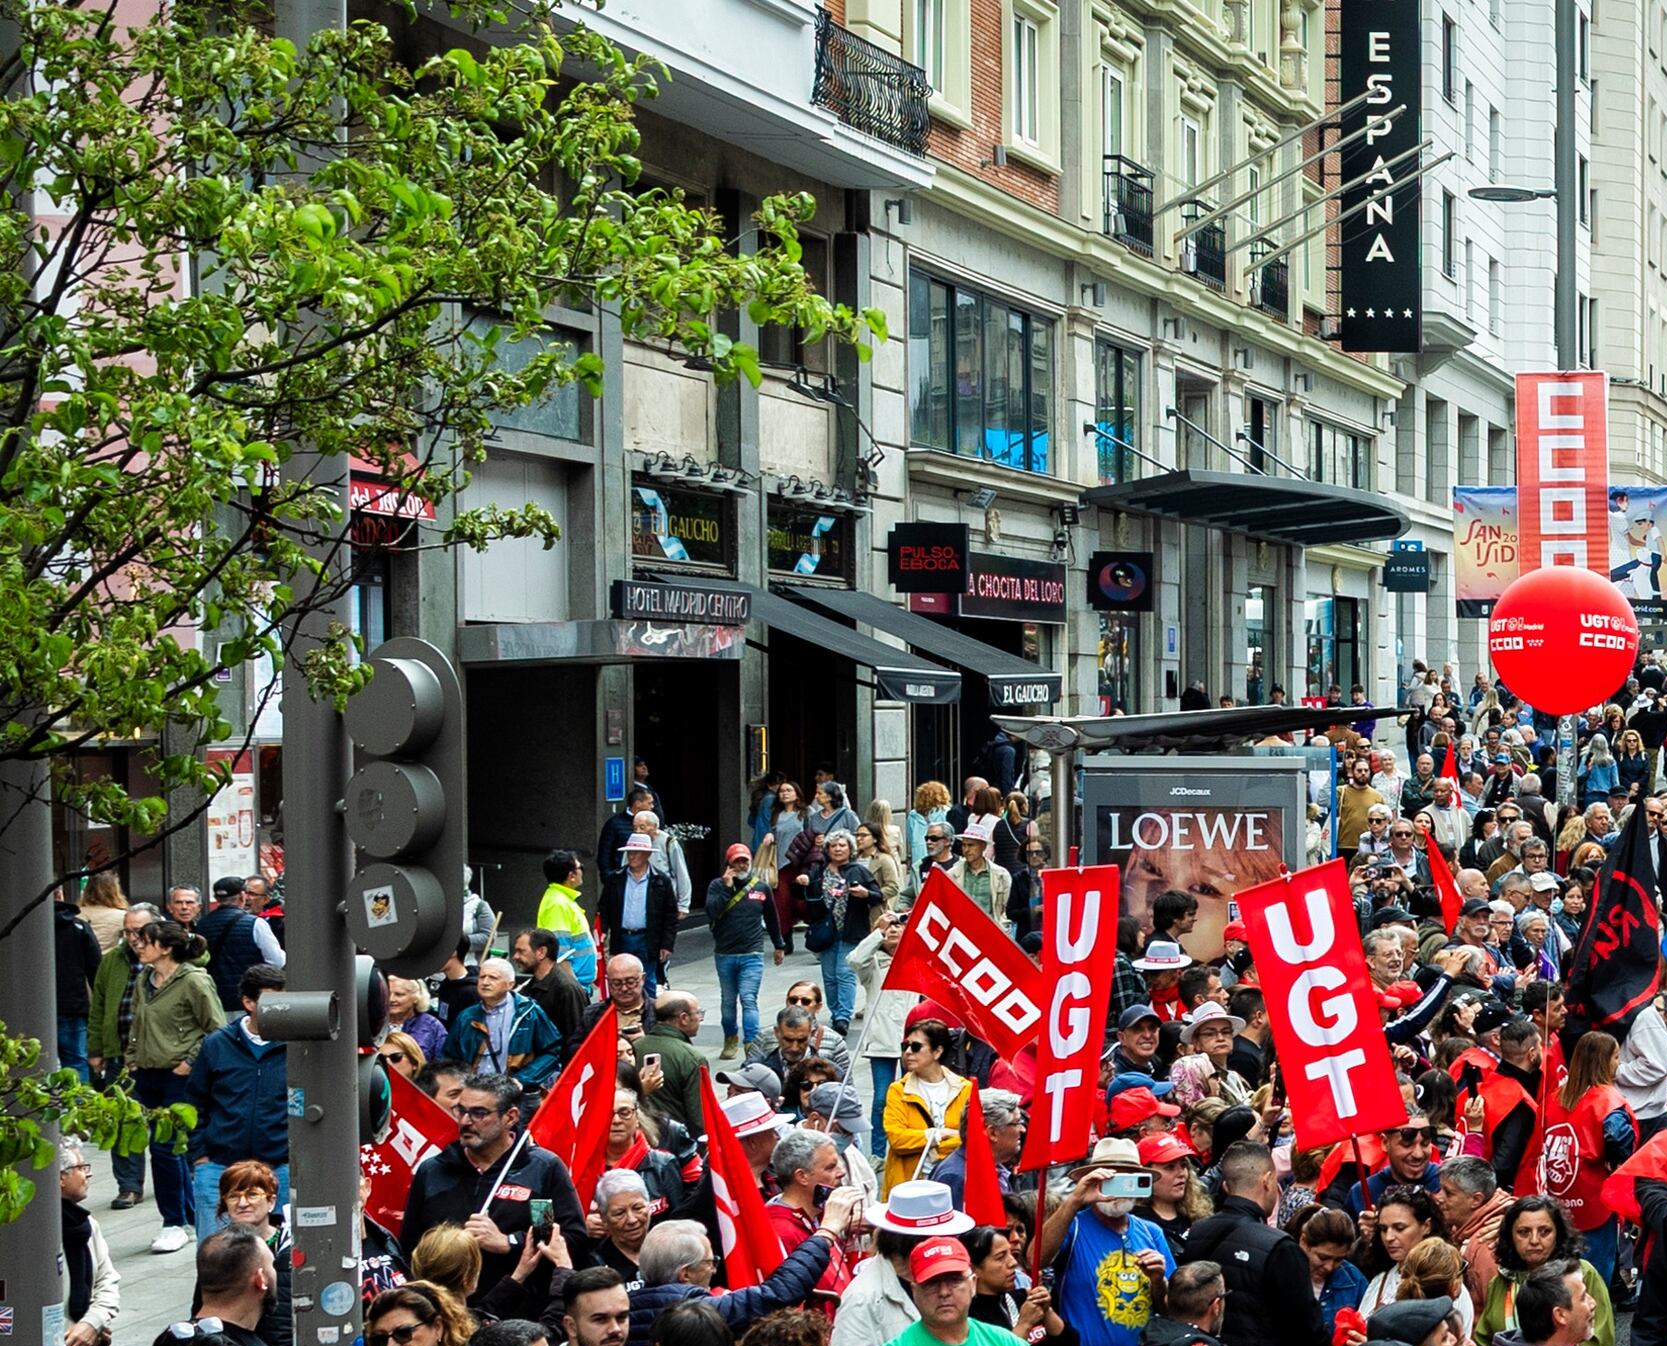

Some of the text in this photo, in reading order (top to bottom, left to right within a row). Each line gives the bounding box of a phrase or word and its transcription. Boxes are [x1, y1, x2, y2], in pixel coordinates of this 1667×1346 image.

[1366, 32, 1394, 262] ESPAÑA
[669, 516, 719, 544] GAUCHO
[1460, 519, 1501, 545] SAN
[1476, 542, 1515, 567] ISID
[627, 586, 748, 619] HOTEL MADRID CENTRO
[978, 576, 1064, 603] CHOCITA DEL LORO
[1580, 613, 1611, 629] UGT
[1580, 633, 1626, 650] CCOO
[1003, 684, 1049, 704] EL GAUCHO
[1170, 788, 1211, 796] JCDecaux
[1110, 813, 1267, 851] LOEWE
[915, 902, 1042, 1035] CCOO
[1046, 890, 1101, 1144] UGT
[1263, 888, 1368, 1120] UGT
